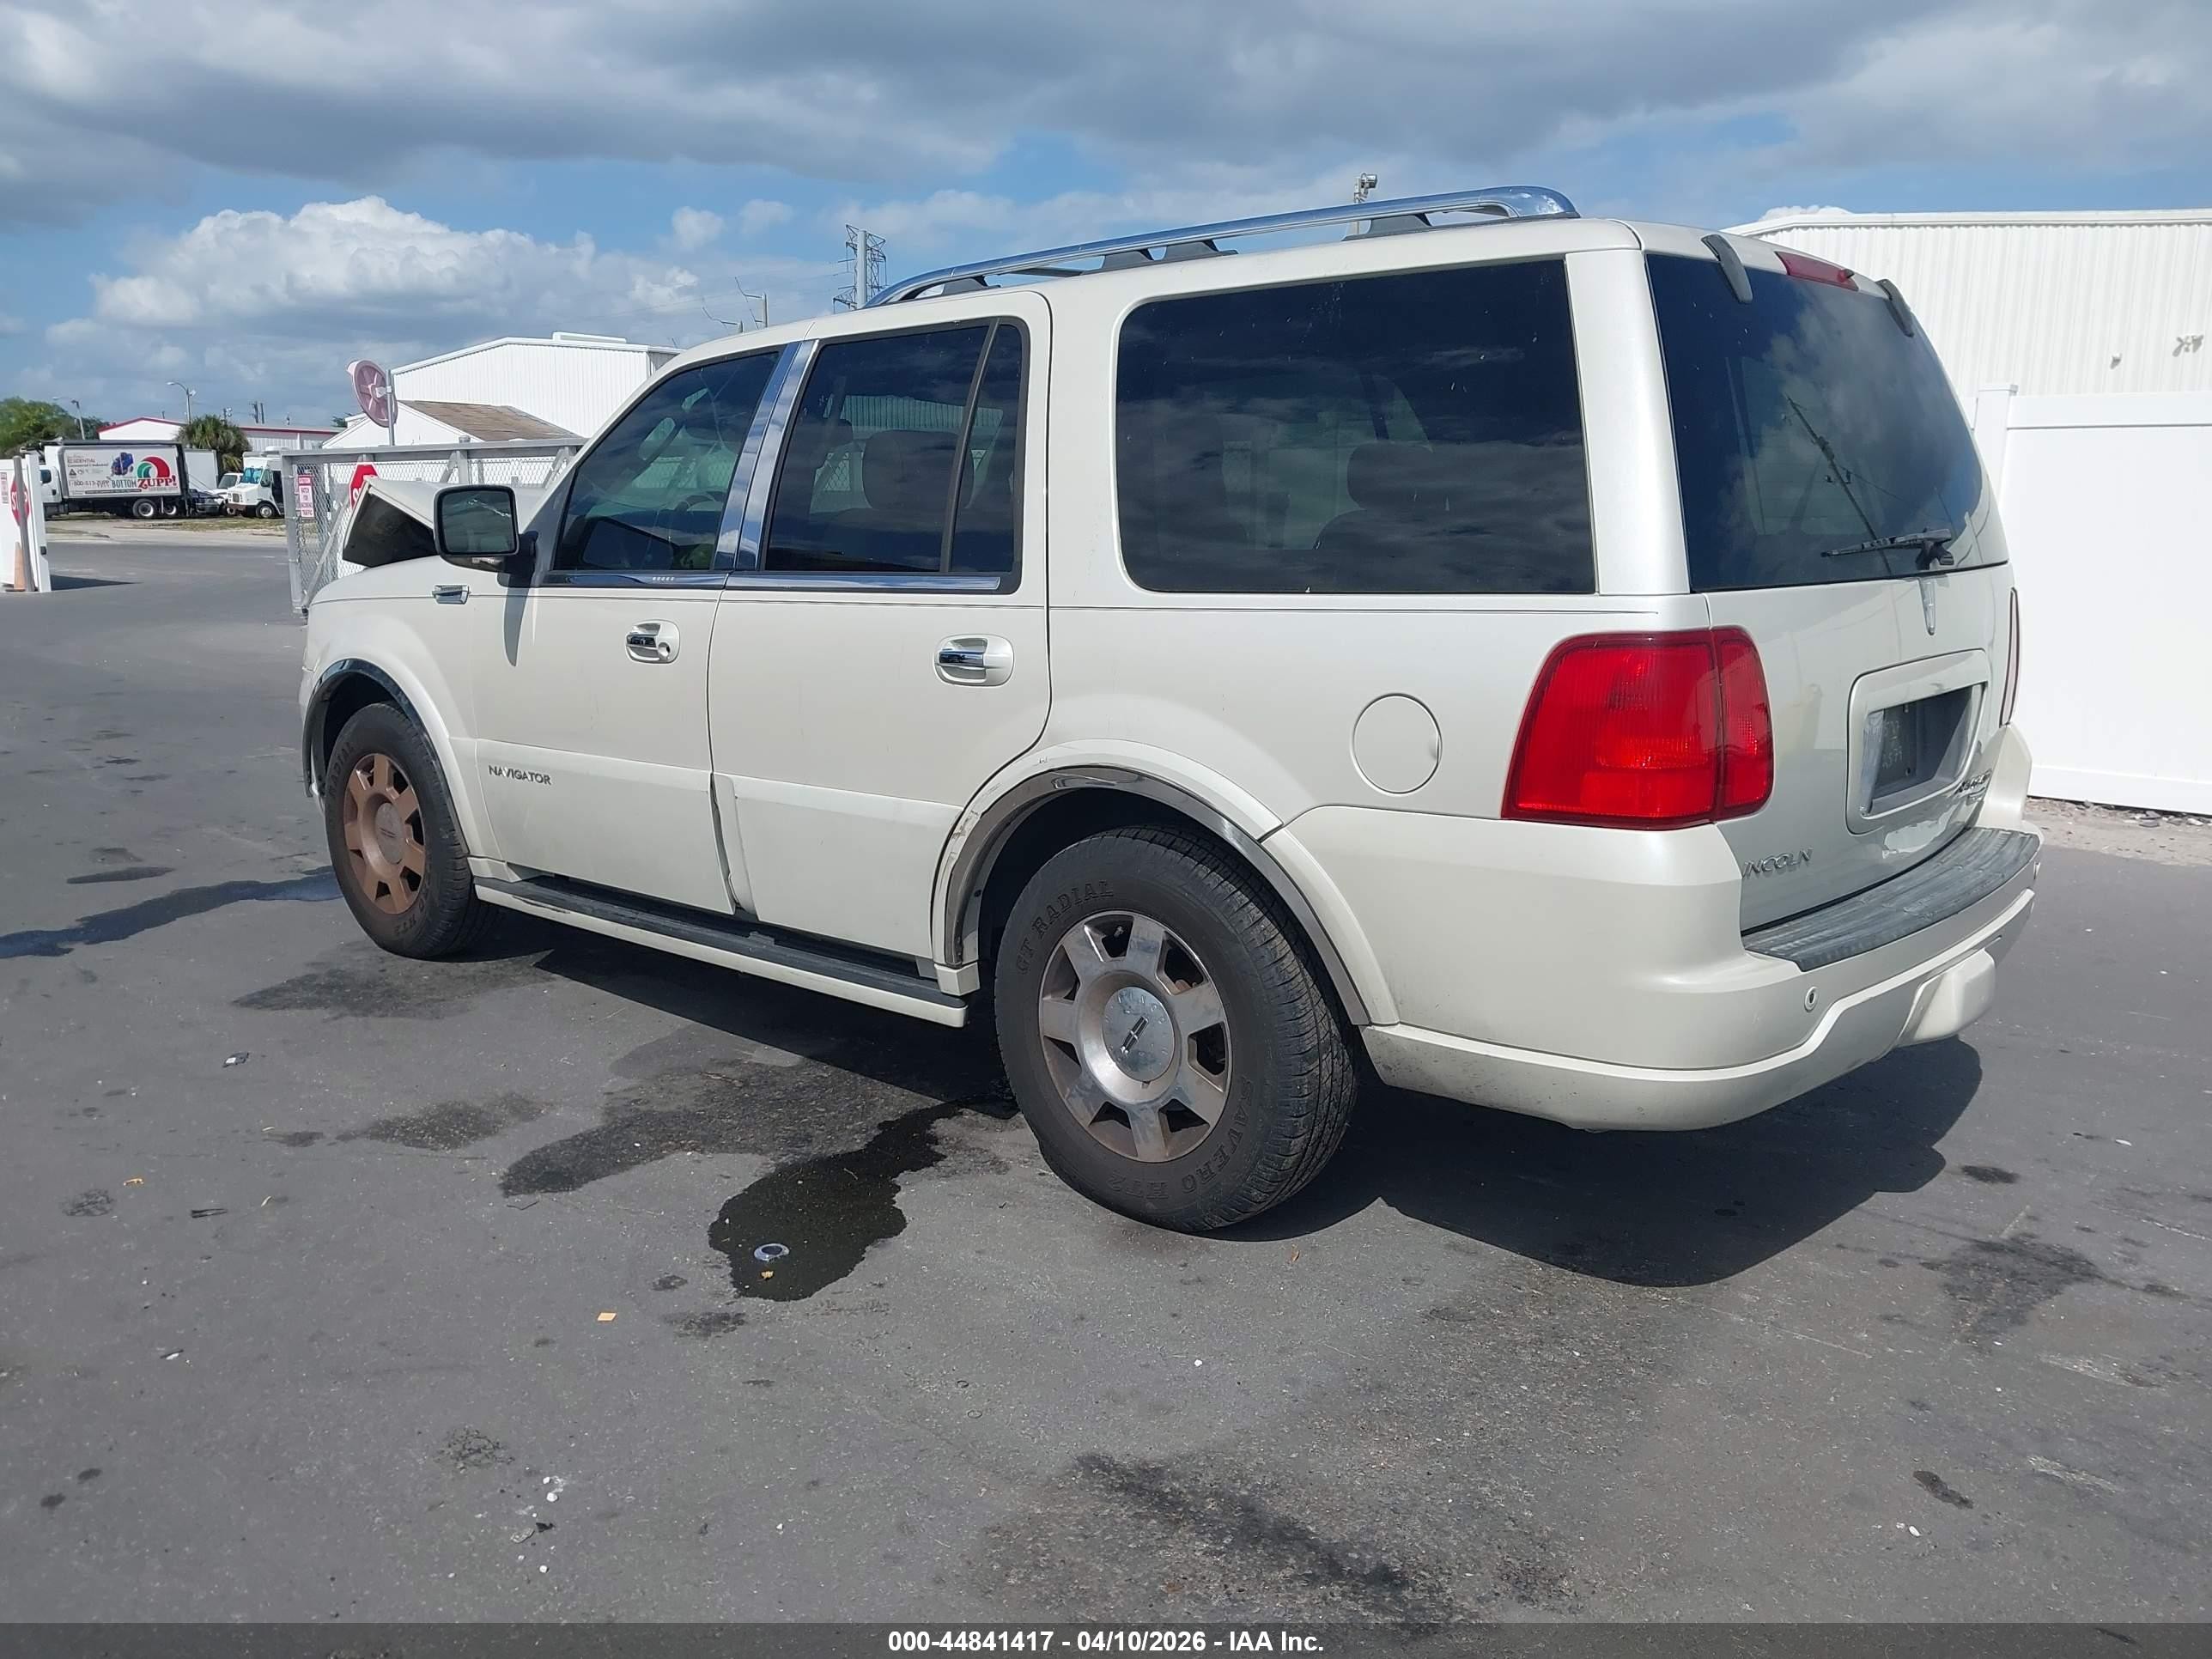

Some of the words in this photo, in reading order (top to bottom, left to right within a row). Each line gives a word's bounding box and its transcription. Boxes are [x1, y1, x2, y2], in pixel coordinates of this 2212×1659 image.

[112, 479, 137, 489] BOTTOM
[137, 475, 177, 489] ZUPP!
[488, 764, 552, 786] NAVIGATOR
[1742, 847, 1814, 878] INCOLN
[1032, 879, 1114, 940] RADIAL
